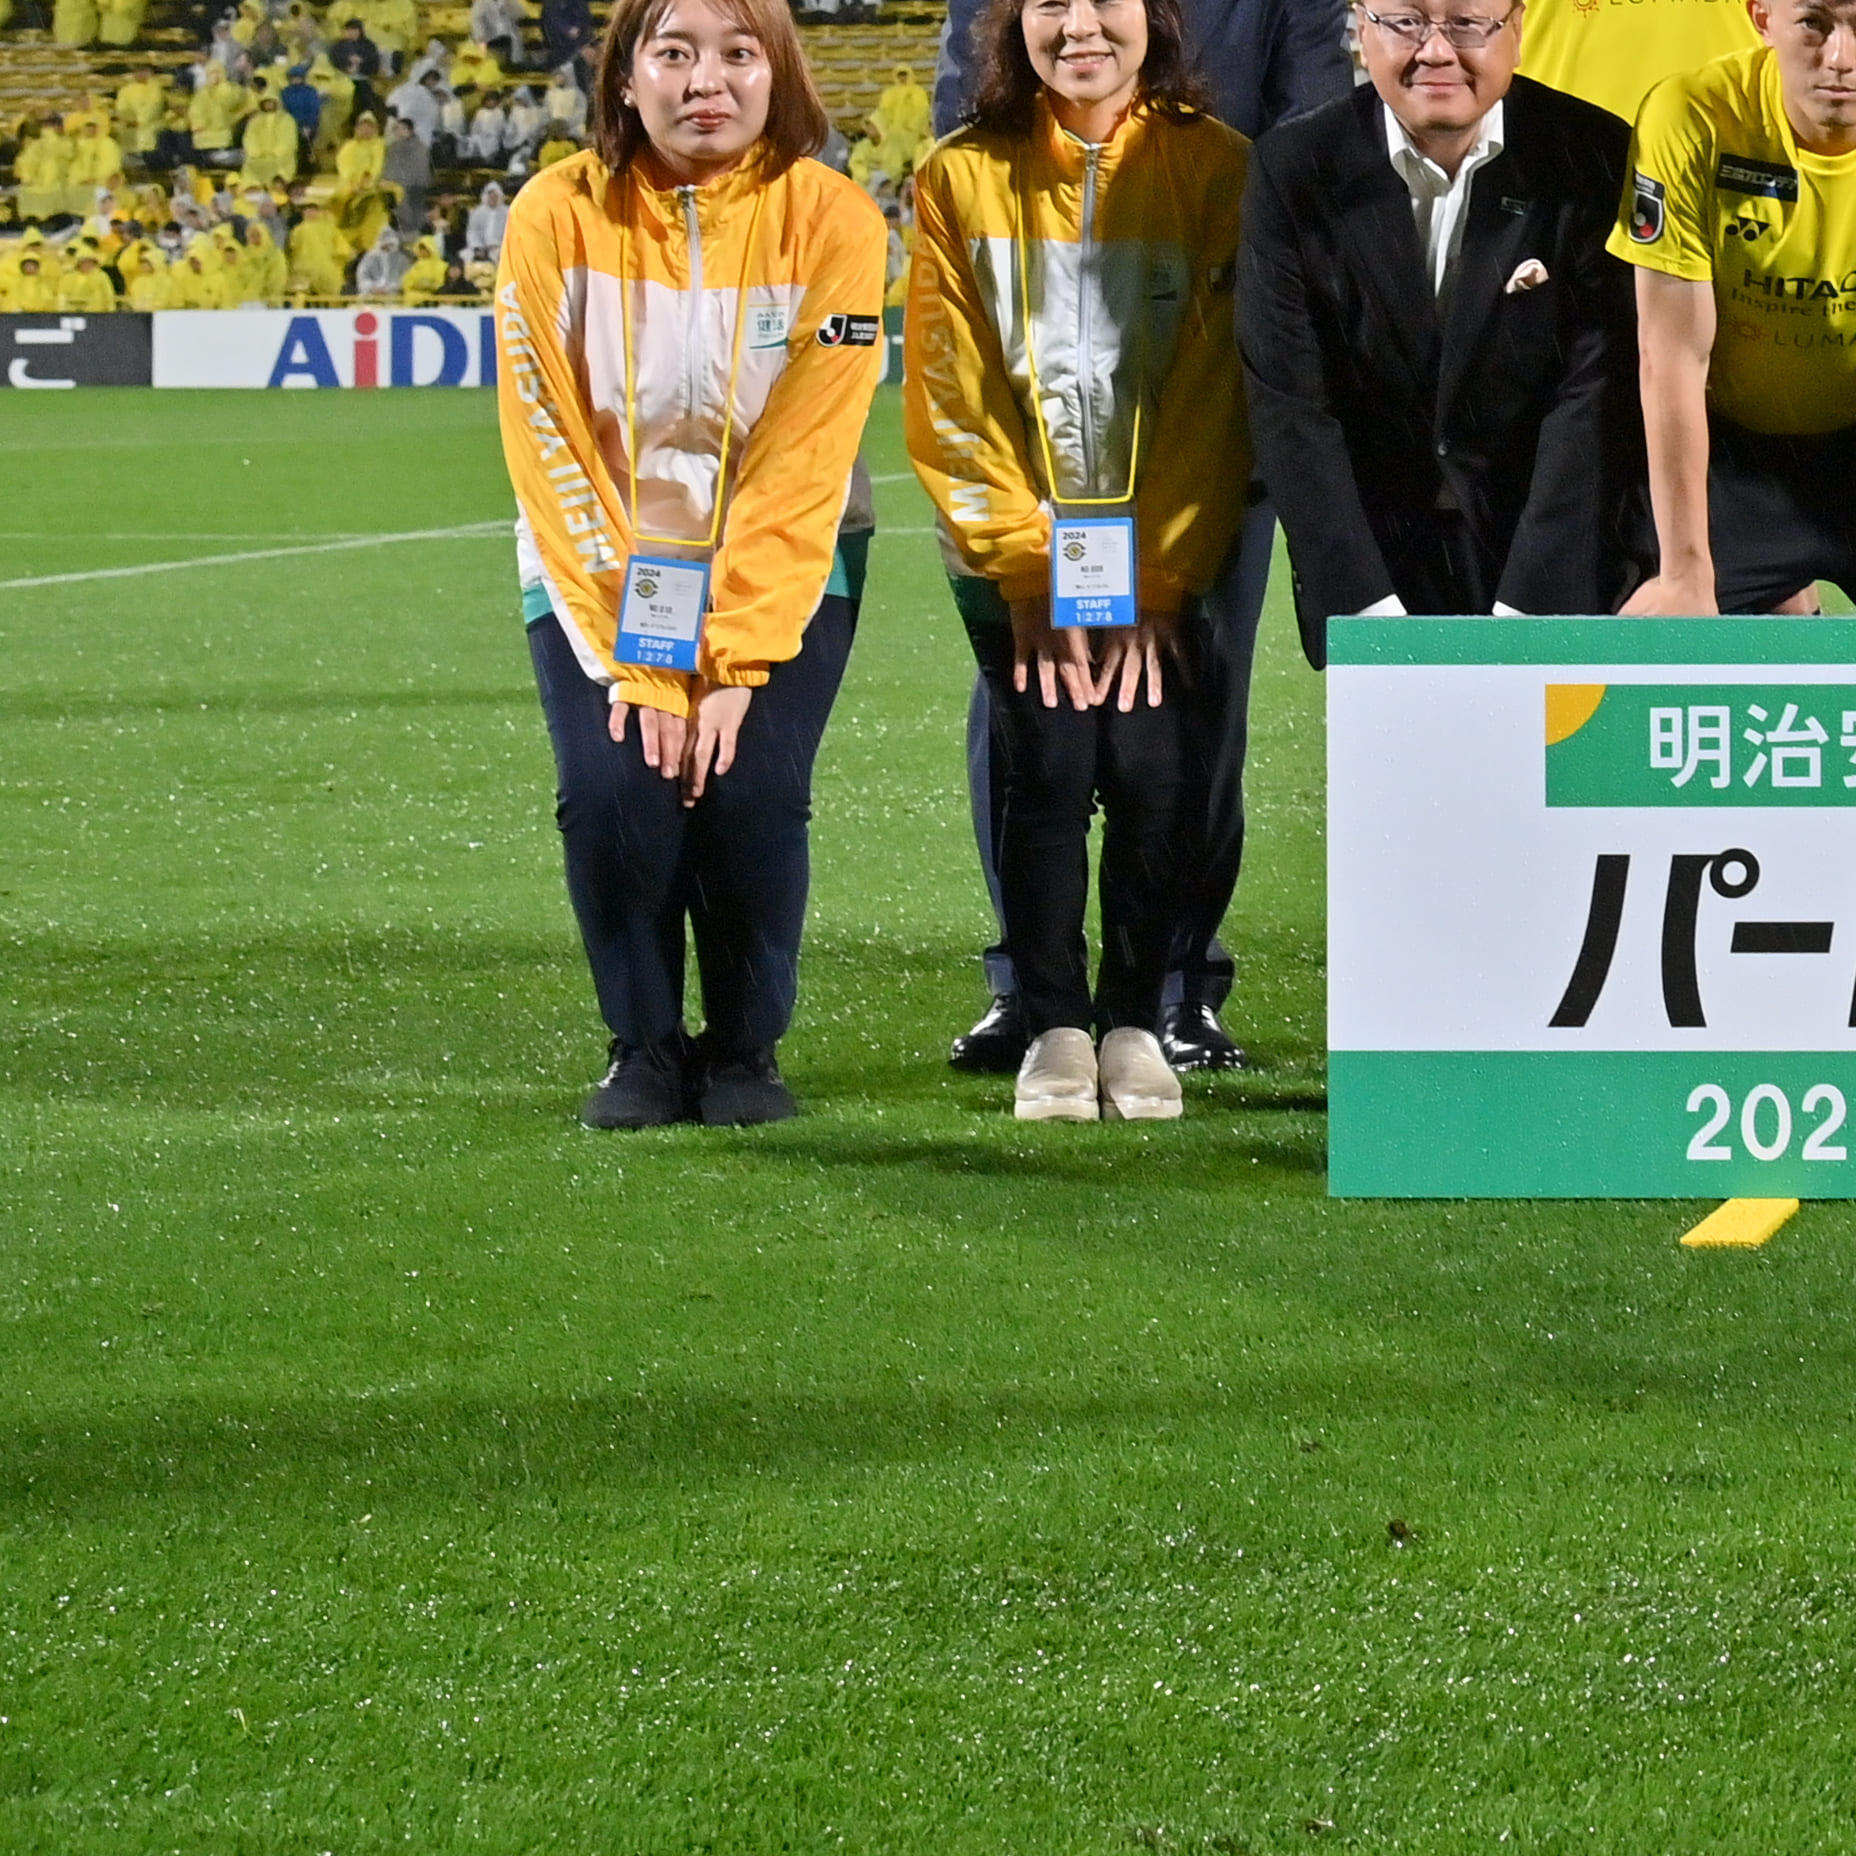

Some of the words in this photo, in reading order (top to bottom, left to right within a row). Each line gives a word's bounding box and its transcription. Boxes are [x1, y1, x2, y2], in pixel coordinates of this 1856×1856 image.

[7, 316, 87, 390] ご
[266, 311, 498, 390] AiD
[501, 280, 568, 460] YASUDA
[547, 462, 621, 574] MEIJI
[1062, 531, 1087, 541] 2024
[637, 567, 661, 578] 2024
[1076, 598, 1111, 610] STAFF
[638, 637, 675, 651] STAFF
